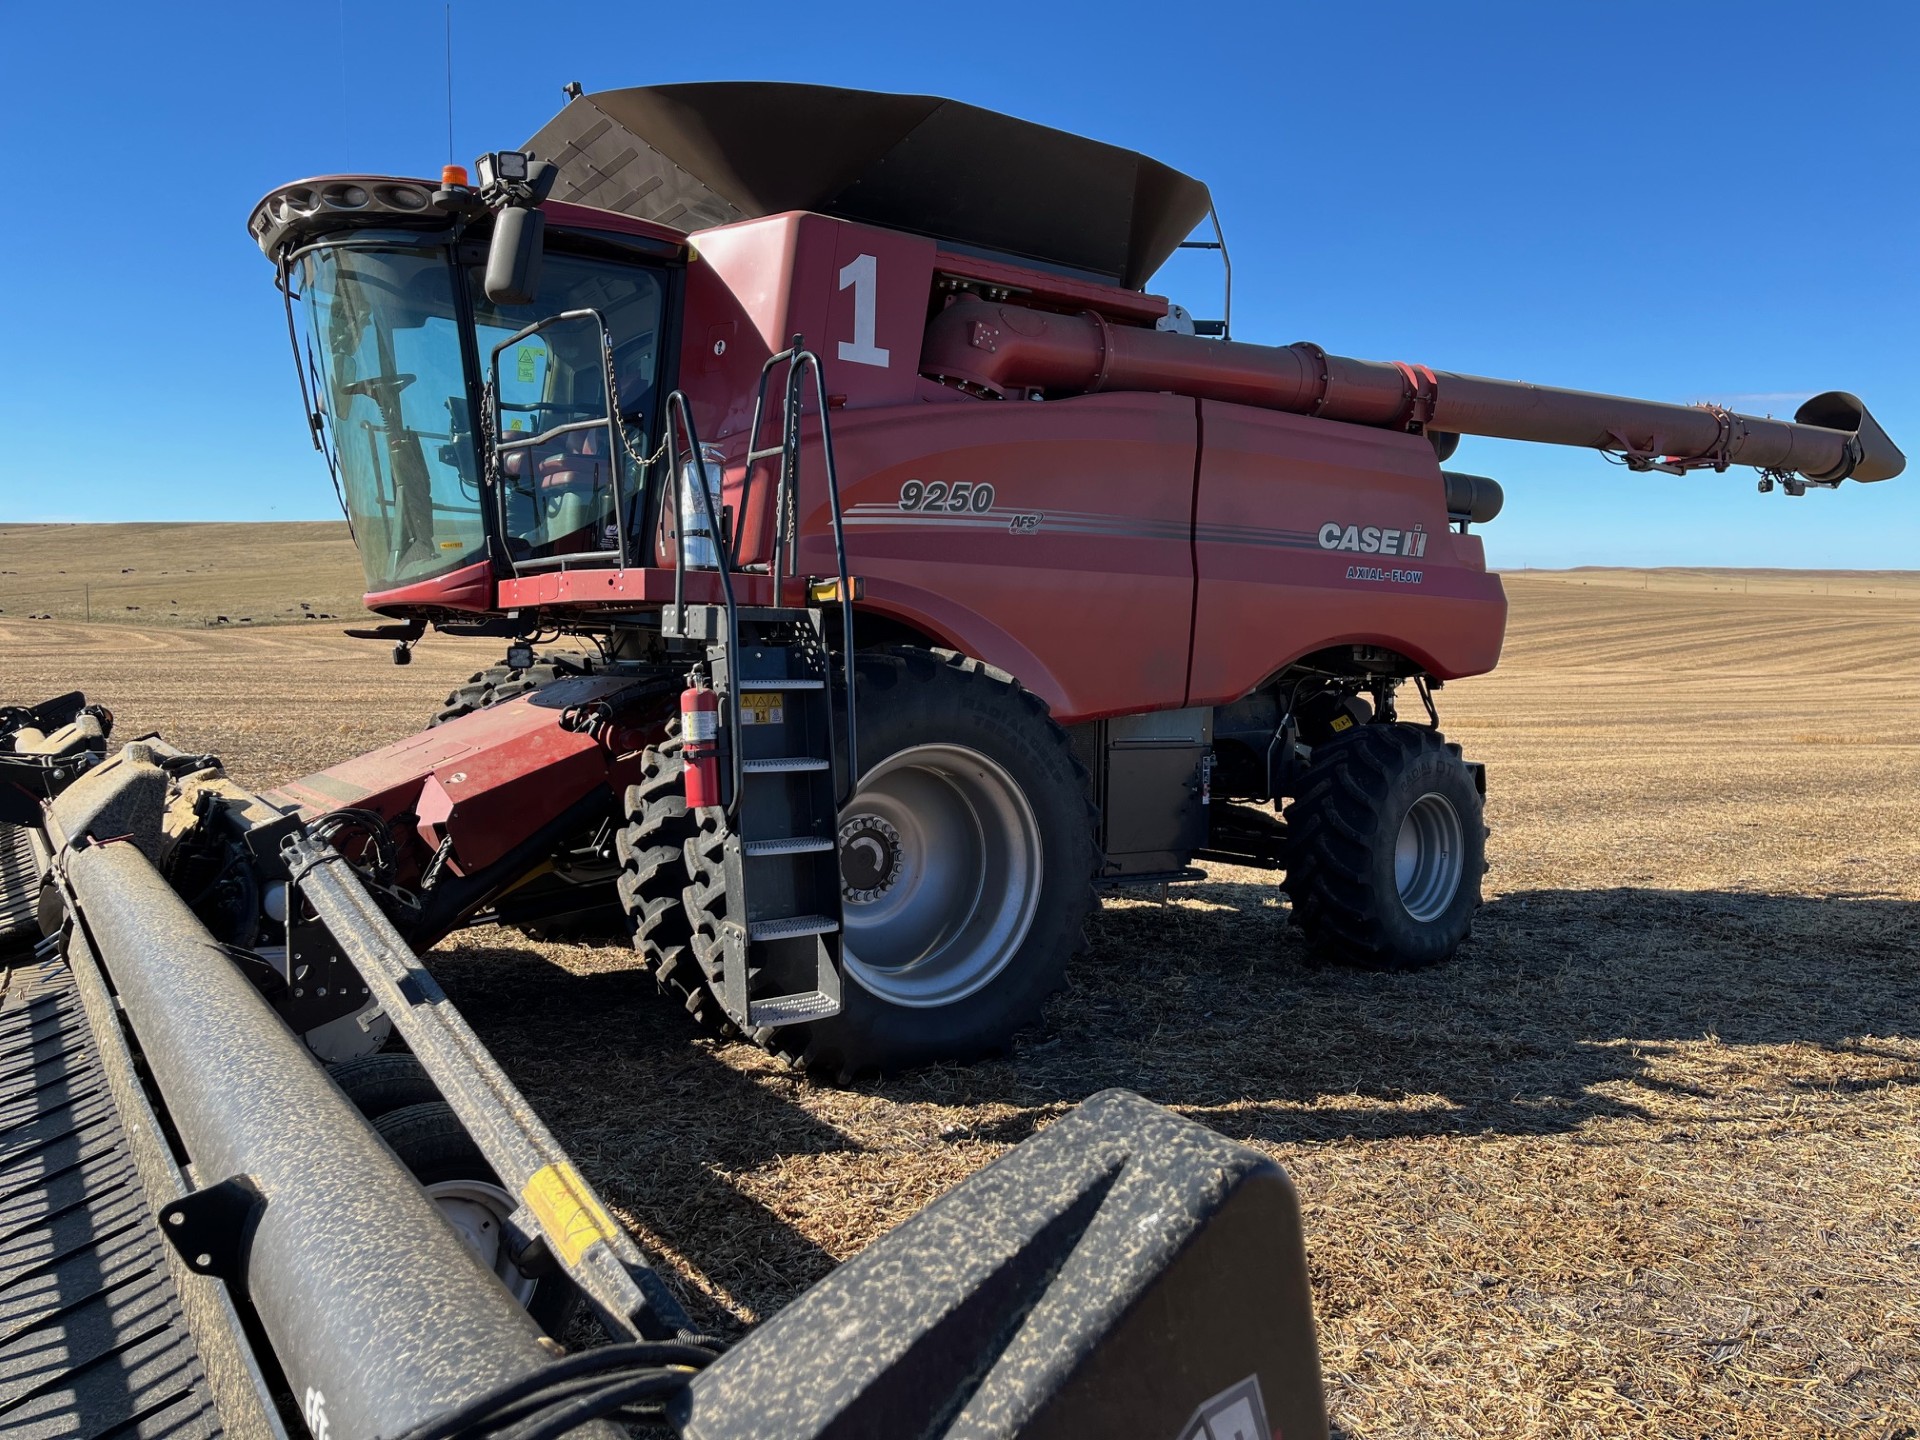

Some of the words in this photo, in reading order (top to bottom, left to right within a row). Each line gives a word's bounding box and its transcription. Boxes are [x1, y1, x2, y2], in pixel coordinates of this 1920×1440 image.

[838, 253, 890, 368] 1
[898, 479, 995, 514] 9250
[1009, 514, 1037, 528] AFS
[1318, 522, 1400, 555] CASE
[1346, 566, 1423, 584] AXIAL-FLOW
